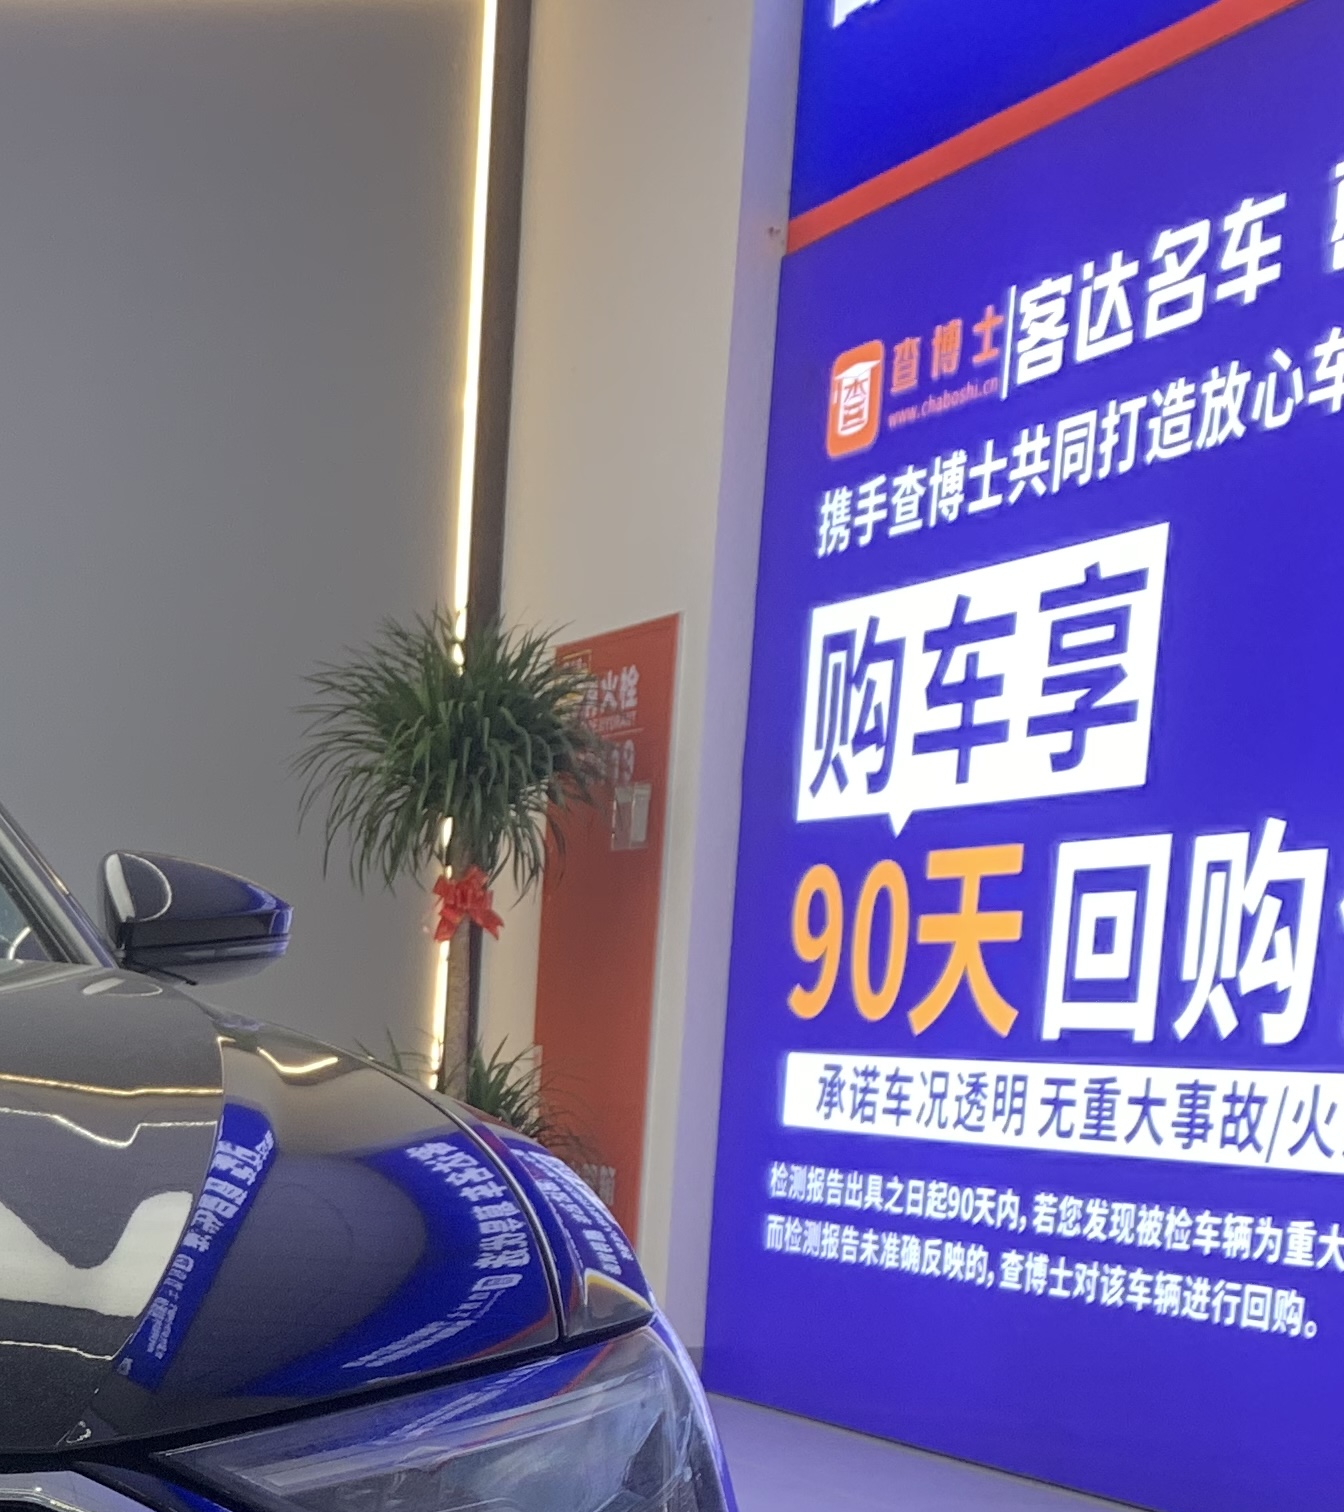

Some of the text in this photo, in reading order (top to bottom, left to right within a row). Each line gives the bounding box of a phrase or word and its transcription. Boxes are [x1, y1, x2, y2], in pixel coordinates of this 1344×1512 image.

[890, 304, 1003, 395] 查博士
[1016, 192, 1287, 386] 客达名车
[818, 326, 1344, 558] 携手查博士共同打造放心车
[809, 561, 1150, 798] 购车享
[816, 1063, 1028, 1137] 承诺车况透明
